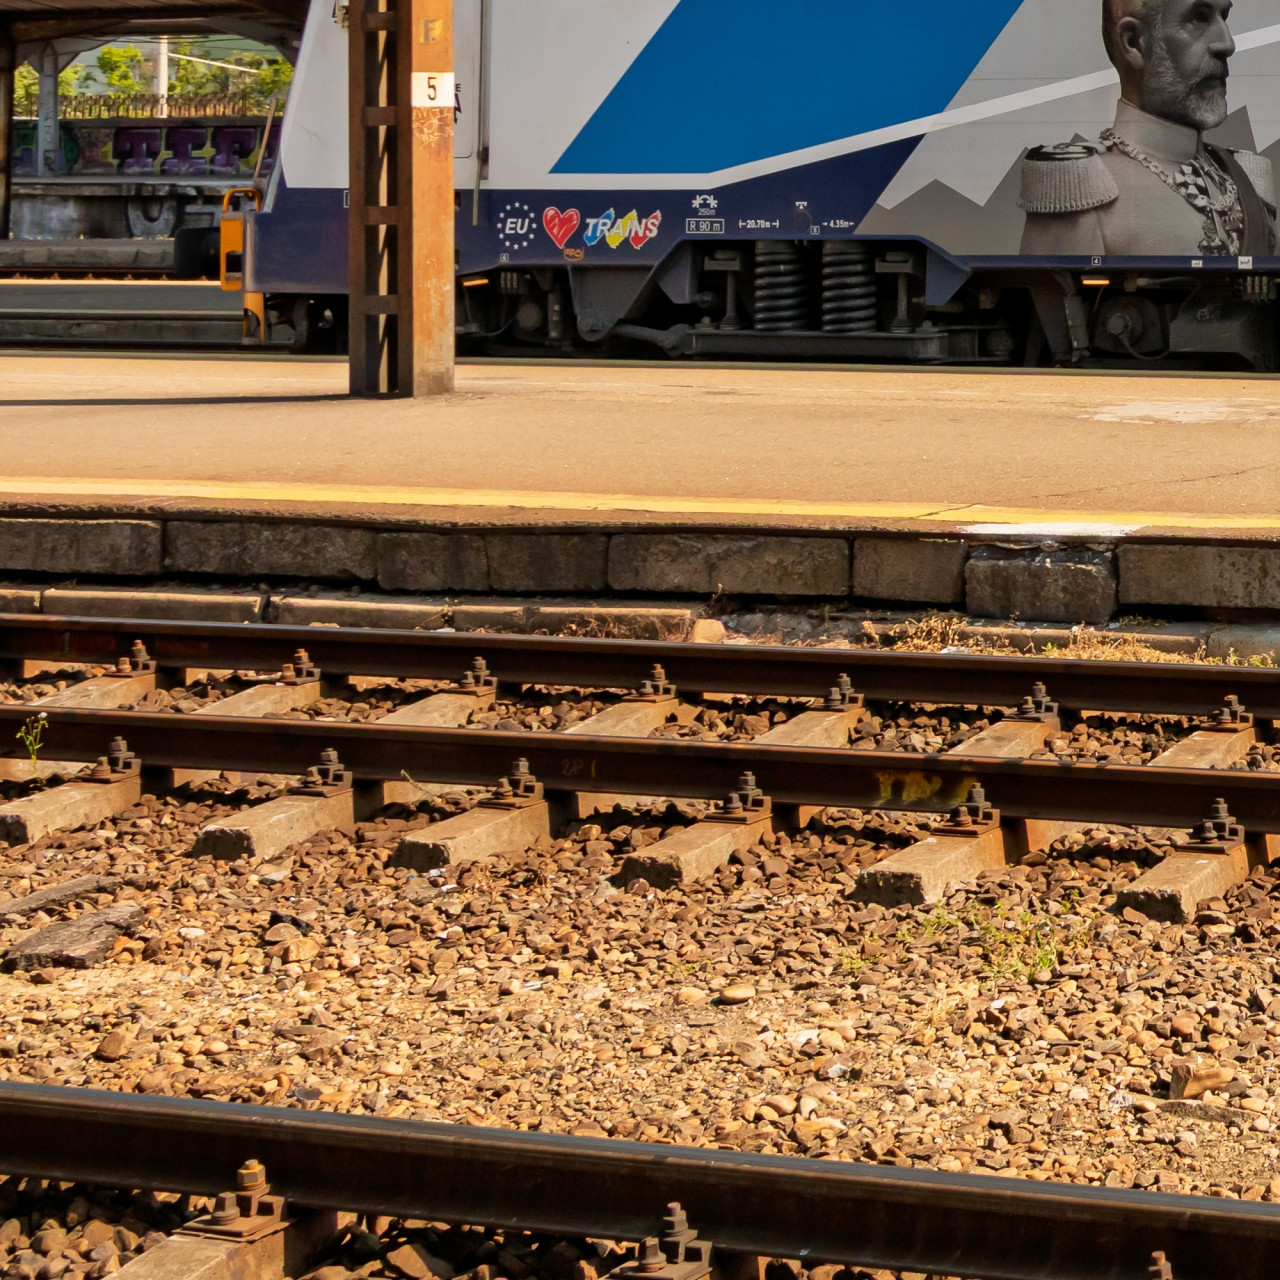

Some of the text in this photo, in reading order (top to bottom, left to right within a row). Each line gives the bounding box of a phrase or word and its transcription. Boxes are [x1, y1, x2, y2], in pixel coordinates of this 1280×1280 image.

[428, 76, 436, 100] 5
[505, 218, 659, 238] EU TRAINS
[690, 221, 721, 232] R 90 m
[746, 220, 771, 228] 20.70m
[829, 220, 849, 228] 4.35m
